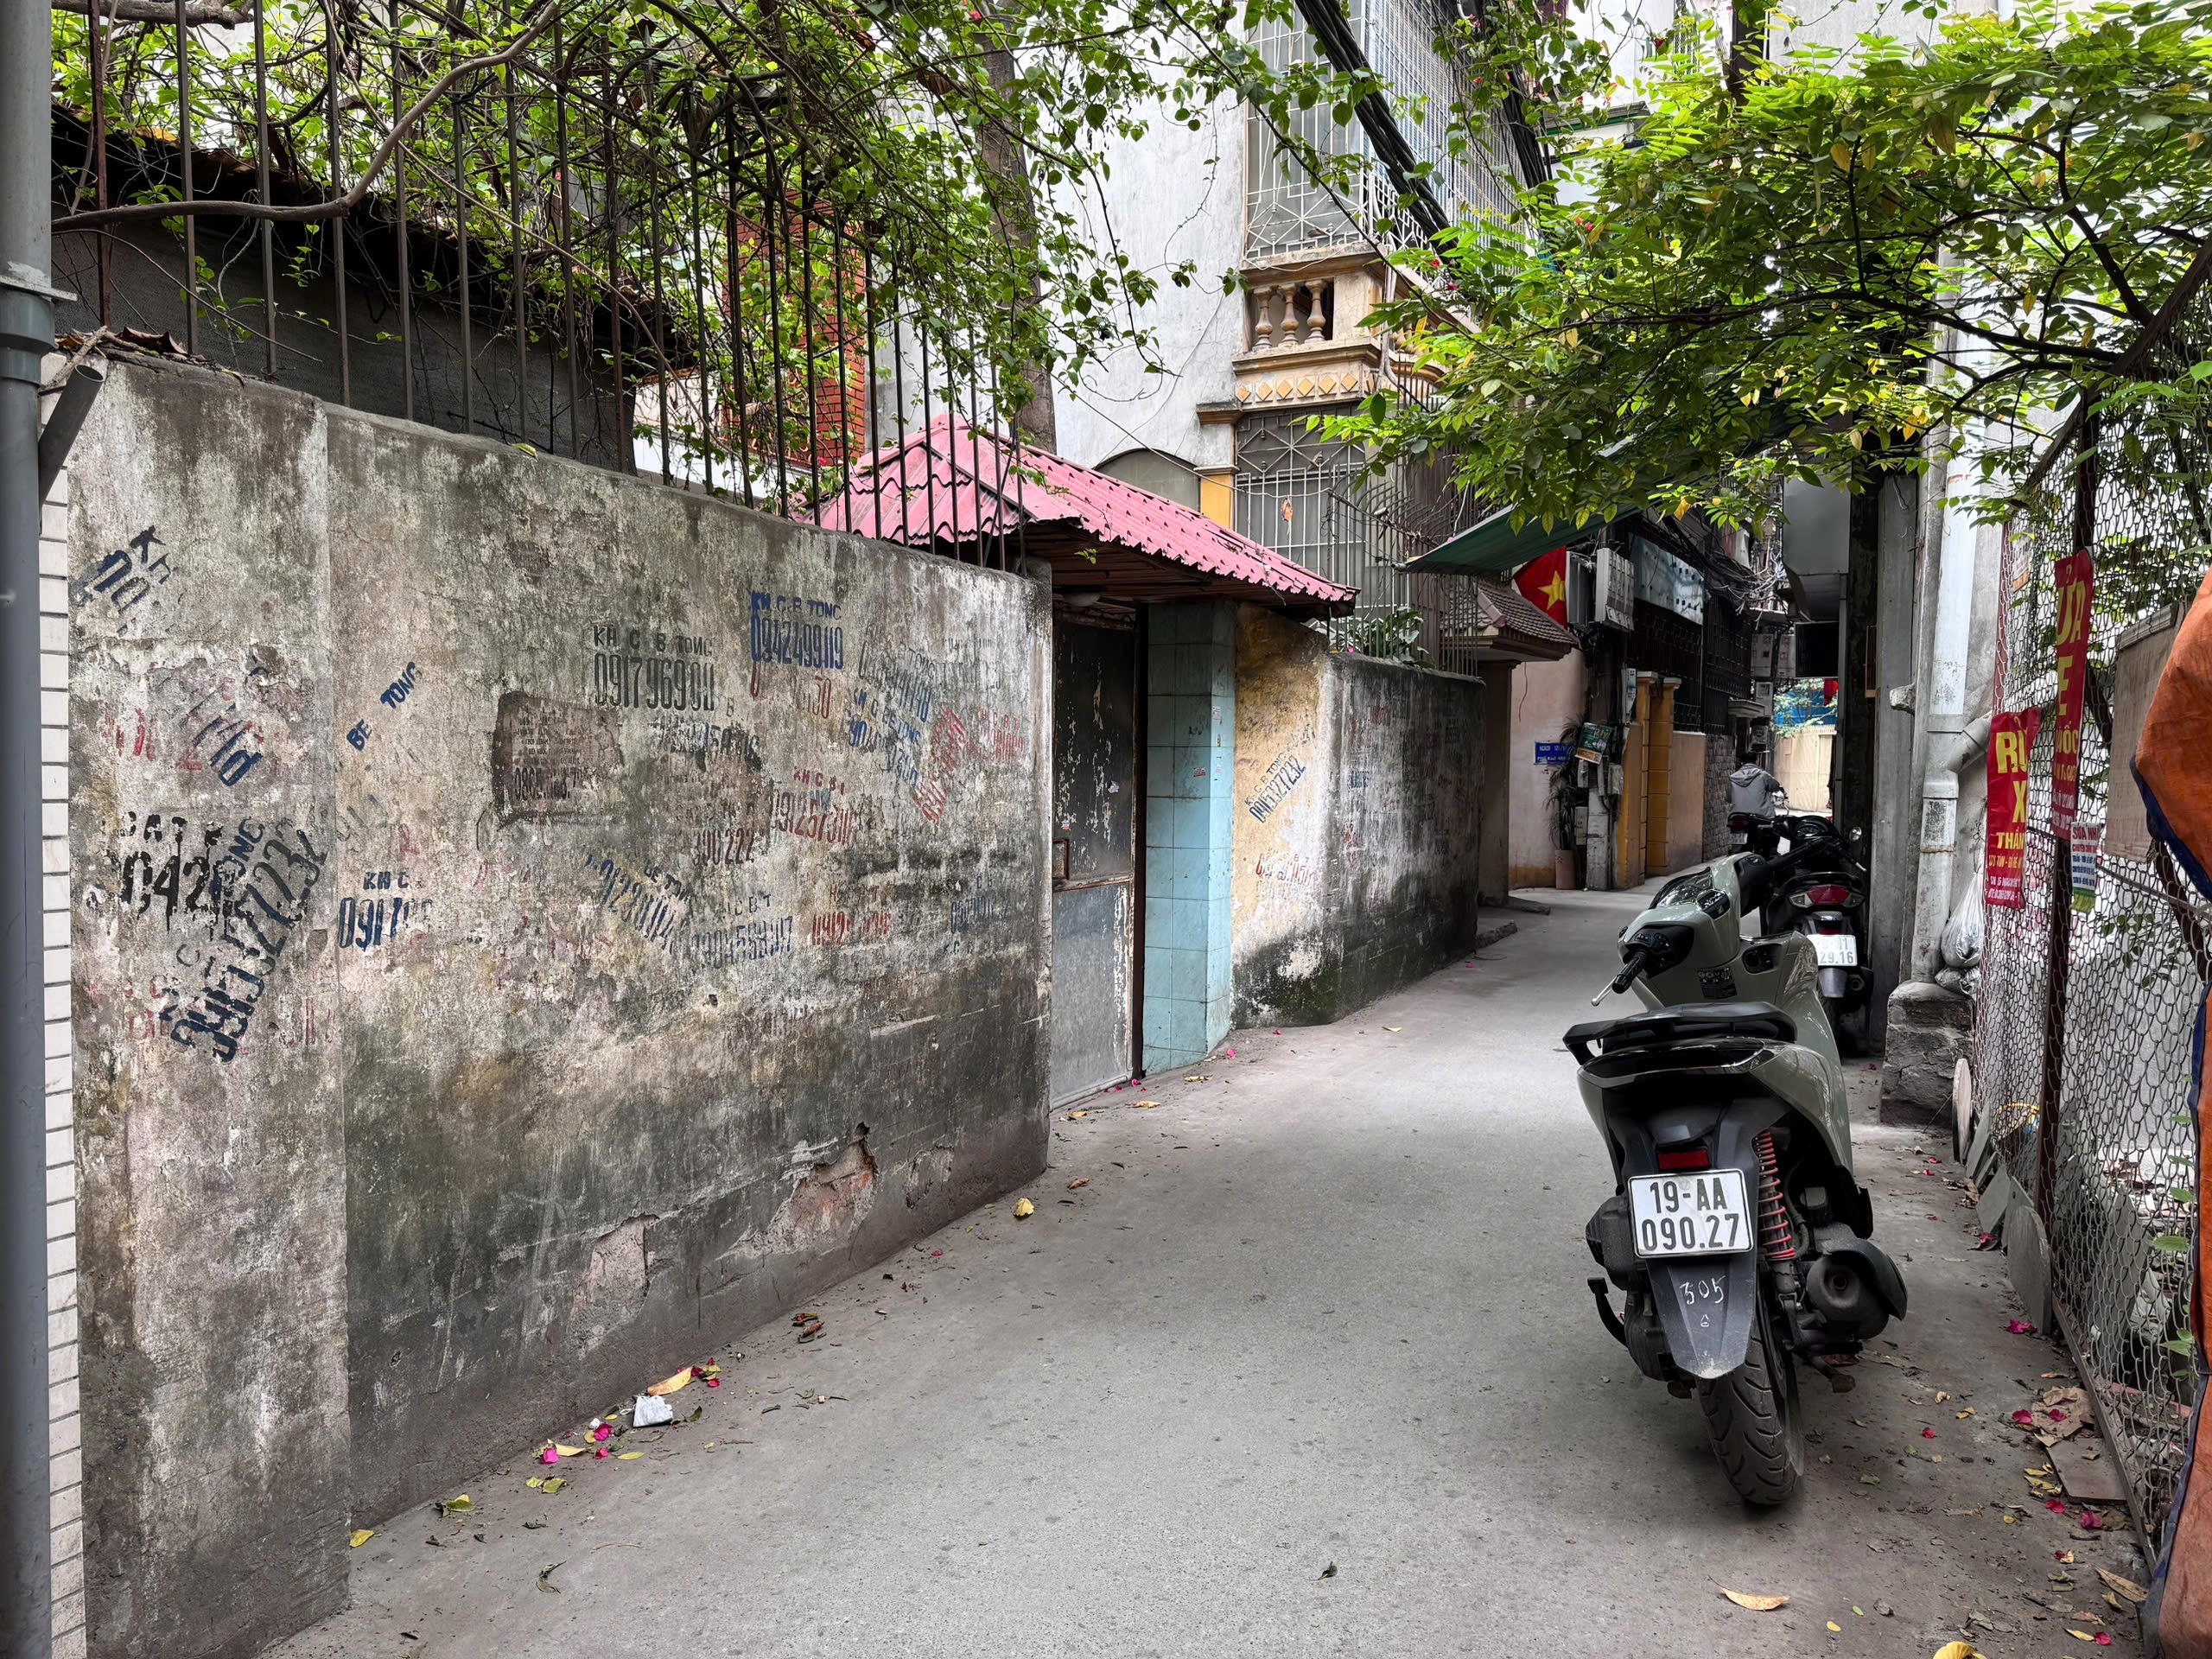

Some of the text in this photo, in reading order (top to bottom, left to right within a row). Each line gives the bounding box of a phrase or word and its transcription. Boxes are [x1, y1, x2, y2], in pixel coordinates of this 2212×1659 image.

[346, 720, 372, 751] BE
[1820, 950, 1853, 964] 29.16
[1649, 1177, 1728, 1214] 19-AA
[1641, 1213, 1739, 1251] 090.27
